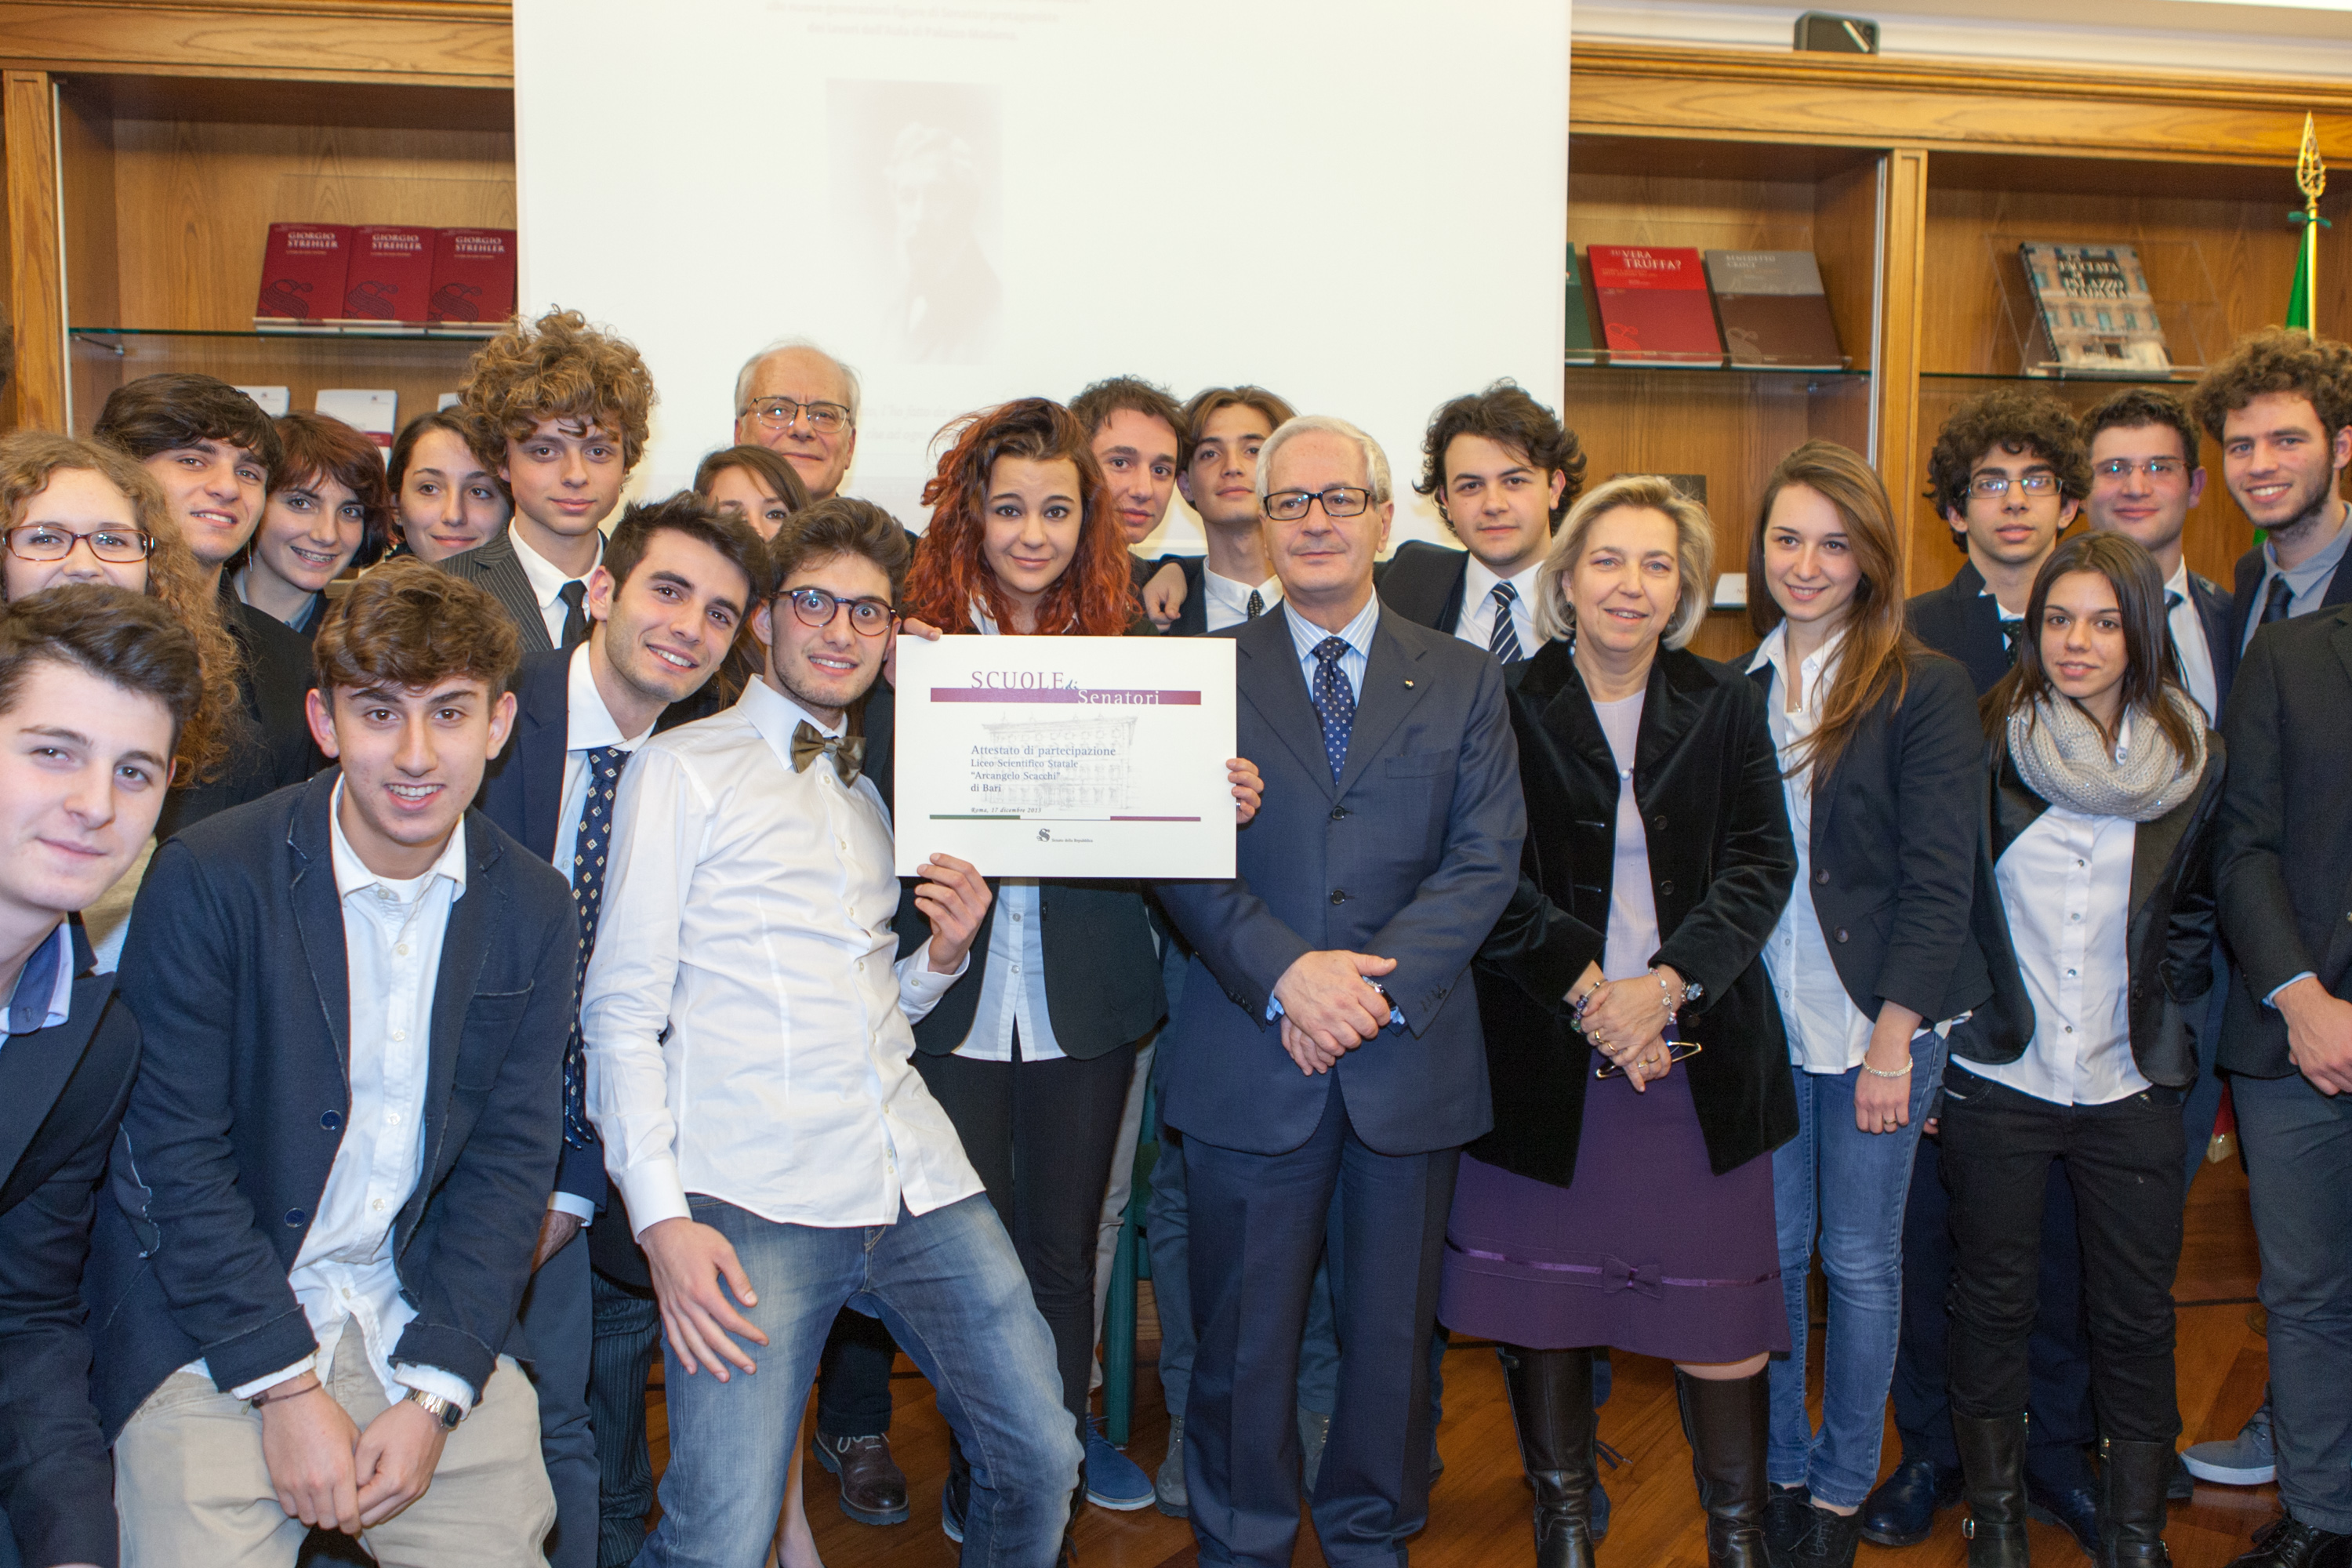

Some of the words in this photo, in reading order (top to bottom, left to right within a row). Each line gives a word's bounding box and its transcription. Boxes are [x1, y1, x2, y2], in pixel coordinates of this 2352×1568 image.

[288, 231, 336, 240] GIORGIO
[372, 234, 419, 242] GIORGIO
[456, 236, 502, 245] GIORGIO
[288, 239, 339, 249] STREHLER
[372, 241, 422, 251] STREHLER
[456, 245, 505, 253] STREHLER
[1622, 249, 1652, 259] VERA
[1624, 258, 1682, 270] TRUFFA?
[971, 671, 1064, 689] SCUOLE
[1065, 680, 1079, 690] di
[1078, 689, 1160, 706] Senatori
[971, 746, 1020, 755] Attestato
[1024, 746, 1034, 756] di
[1038, 746, 1116, 757] partecipazione
[1047, 760, 1079, 768] Statale
[982, 784, 1002, 793] Bari
